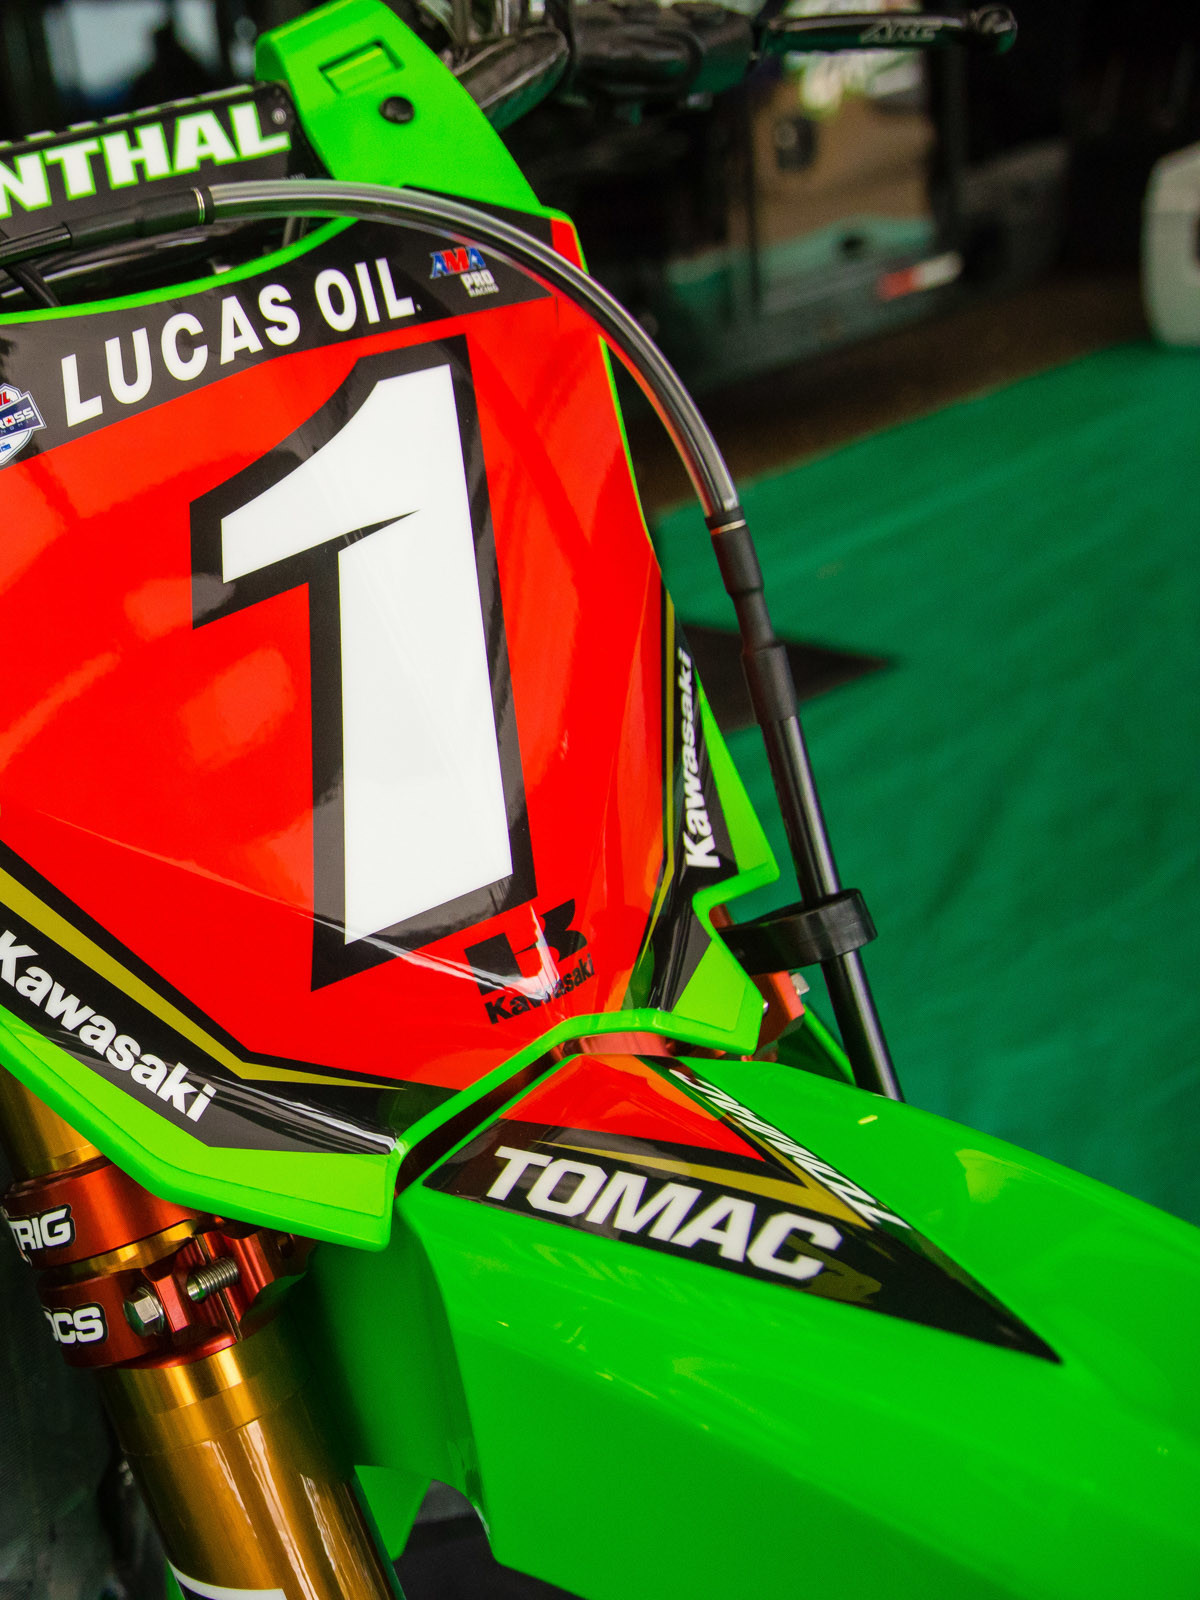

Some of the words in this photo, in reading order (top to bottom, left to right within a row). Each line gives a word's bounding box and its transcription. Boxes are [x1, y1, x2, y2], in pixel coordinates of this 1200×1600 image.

[429, 246, 487, 279] AMA
[460, 269, 494, 290] PRO
[61, 283, 301, 427] LUCAS
[314, 257, 416, 333] OIL
[220, 363, 514, 946] 1
[678, 647, 721, 868] Kawasaki
[485, 1145, 842, 1281] TOMAC
